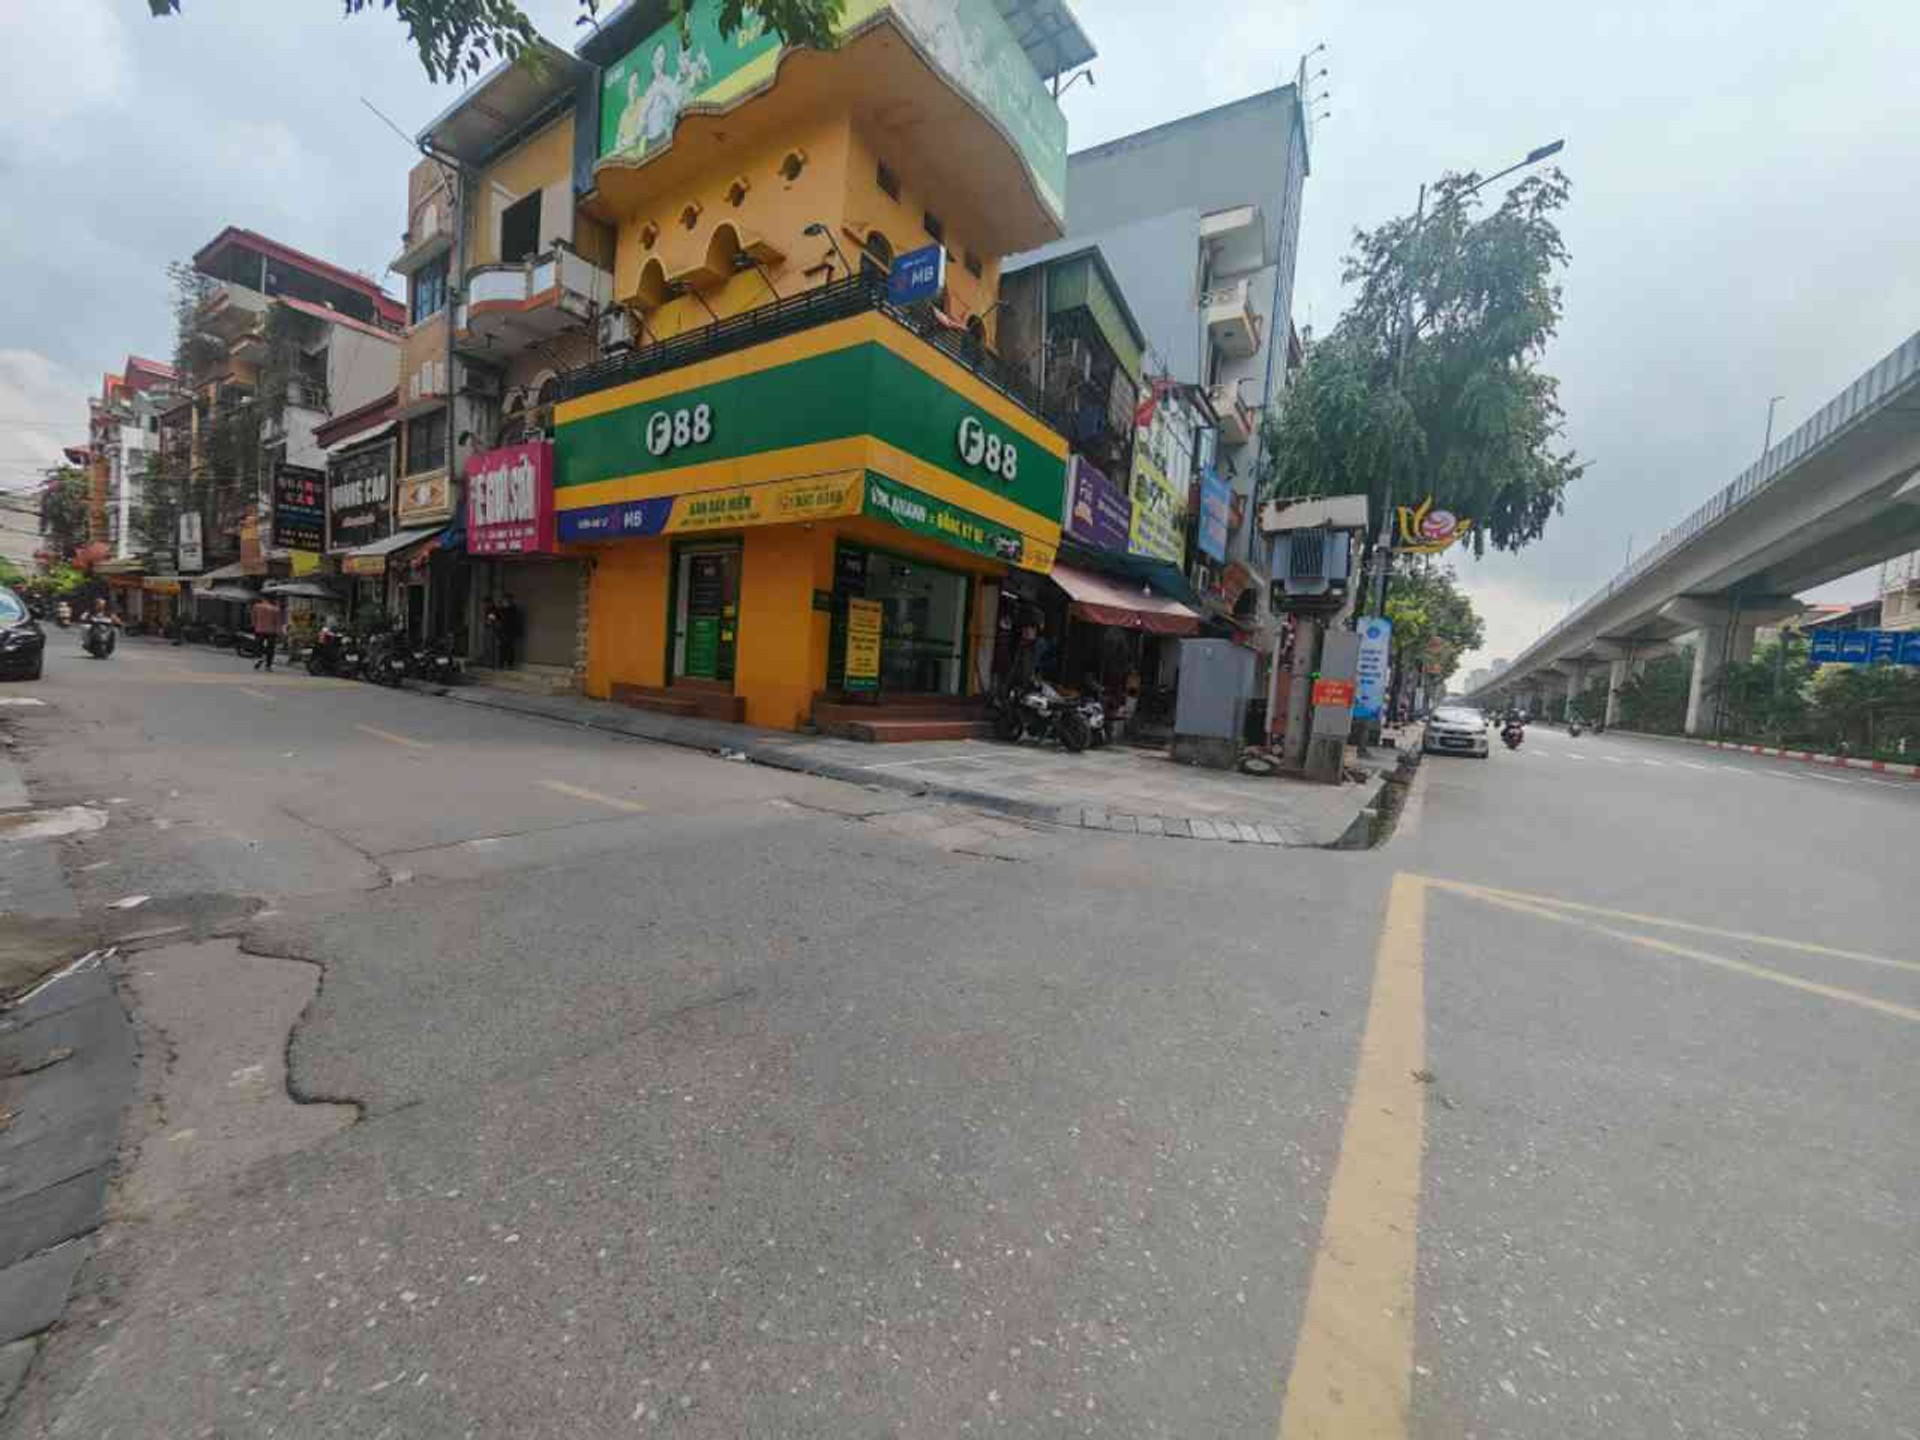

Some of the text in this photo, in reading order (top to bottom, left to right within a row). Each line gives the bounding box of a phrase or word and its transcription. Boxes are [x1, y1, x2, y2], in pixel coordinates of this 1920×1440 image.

[911, 266, 934, 286] MB
[647, 404, 711, 456] F88
[959, 416, 1017, 481] F88
[623, 509, 643, 528] MB
